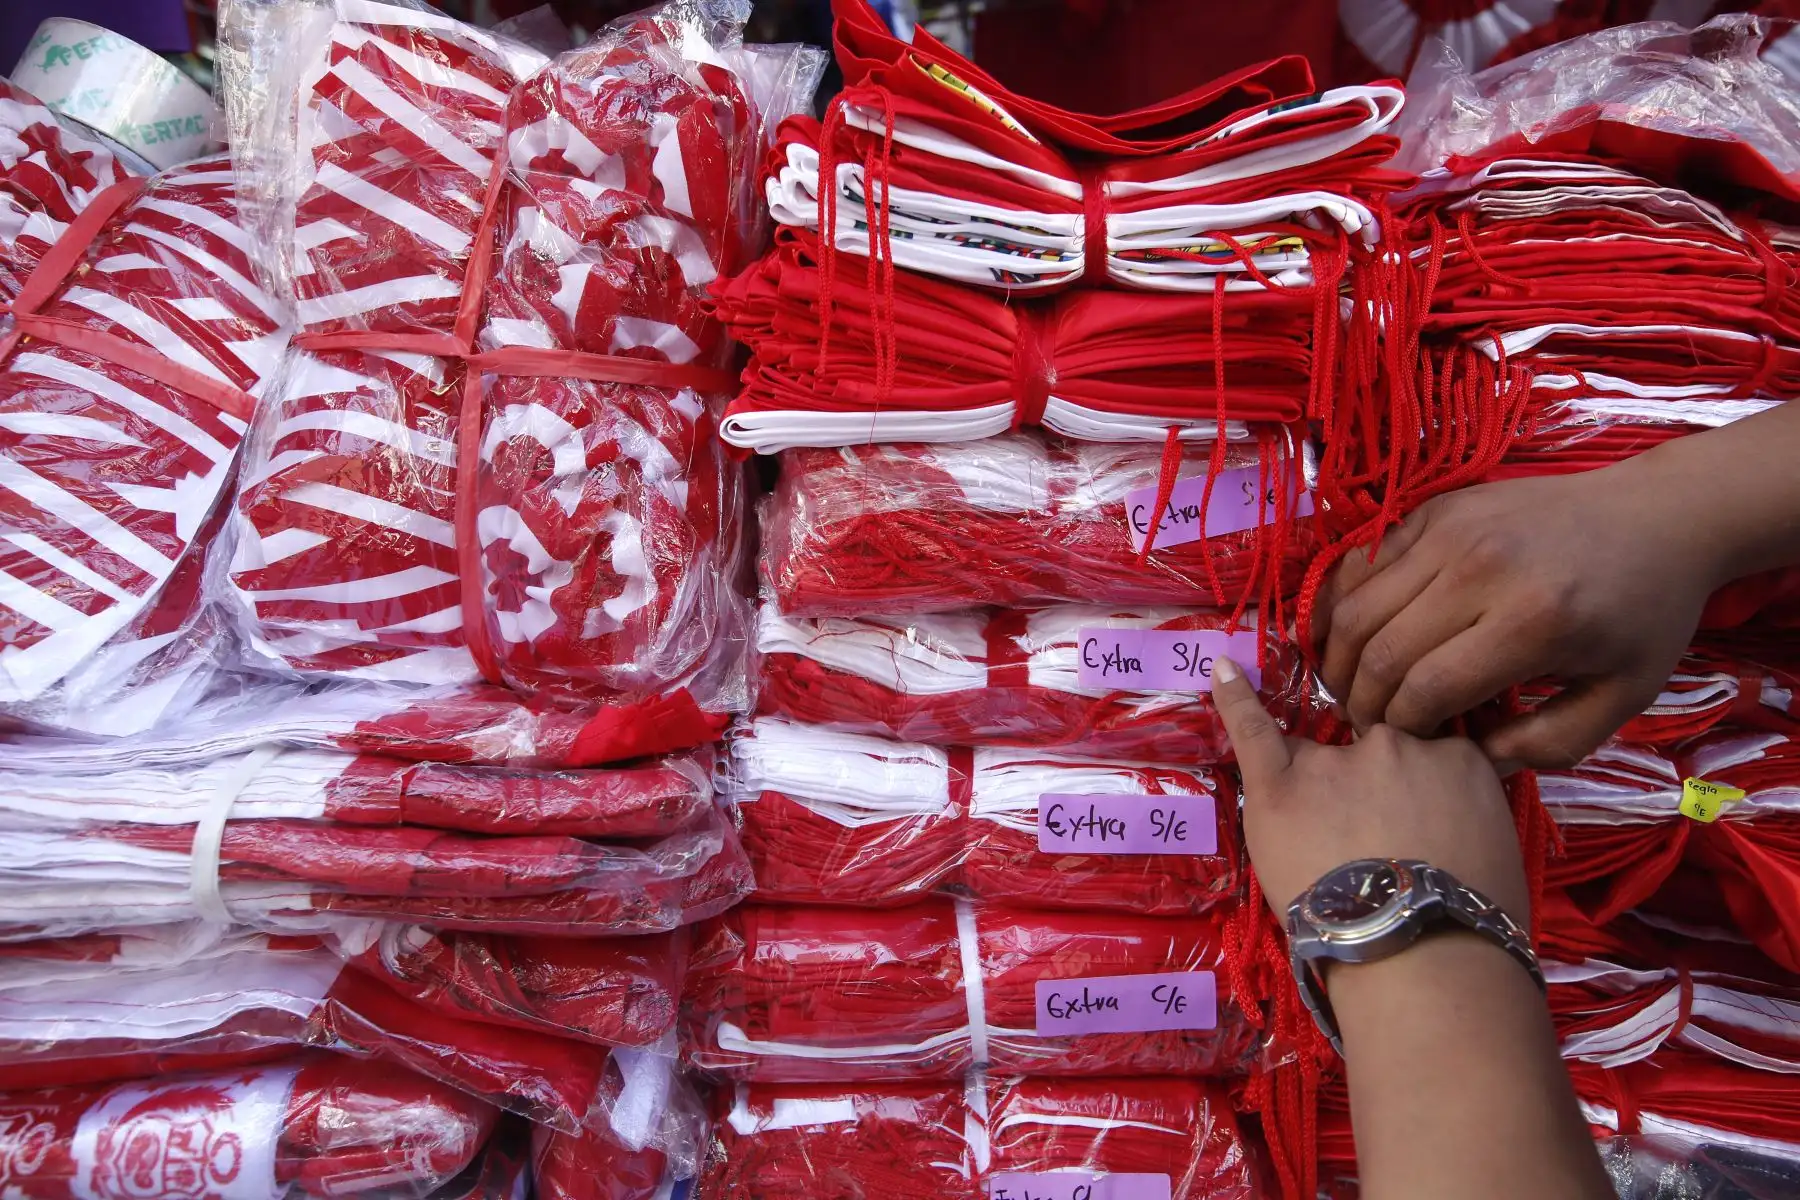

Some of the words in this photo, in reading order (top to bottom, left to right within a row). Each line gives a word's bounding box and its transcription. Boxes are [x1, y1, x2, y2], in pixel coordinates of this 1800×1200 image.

[1083, 637, 1143, 676] Extra
[1172, 642, 1213, 678] S/E
[1046, 803, 1126, 842] Extra
[1150, 808, 1188, 843] S/E
[1047, 987, 1119, 1019] Extra
[1151, 985, 1188, 1014] C/E
